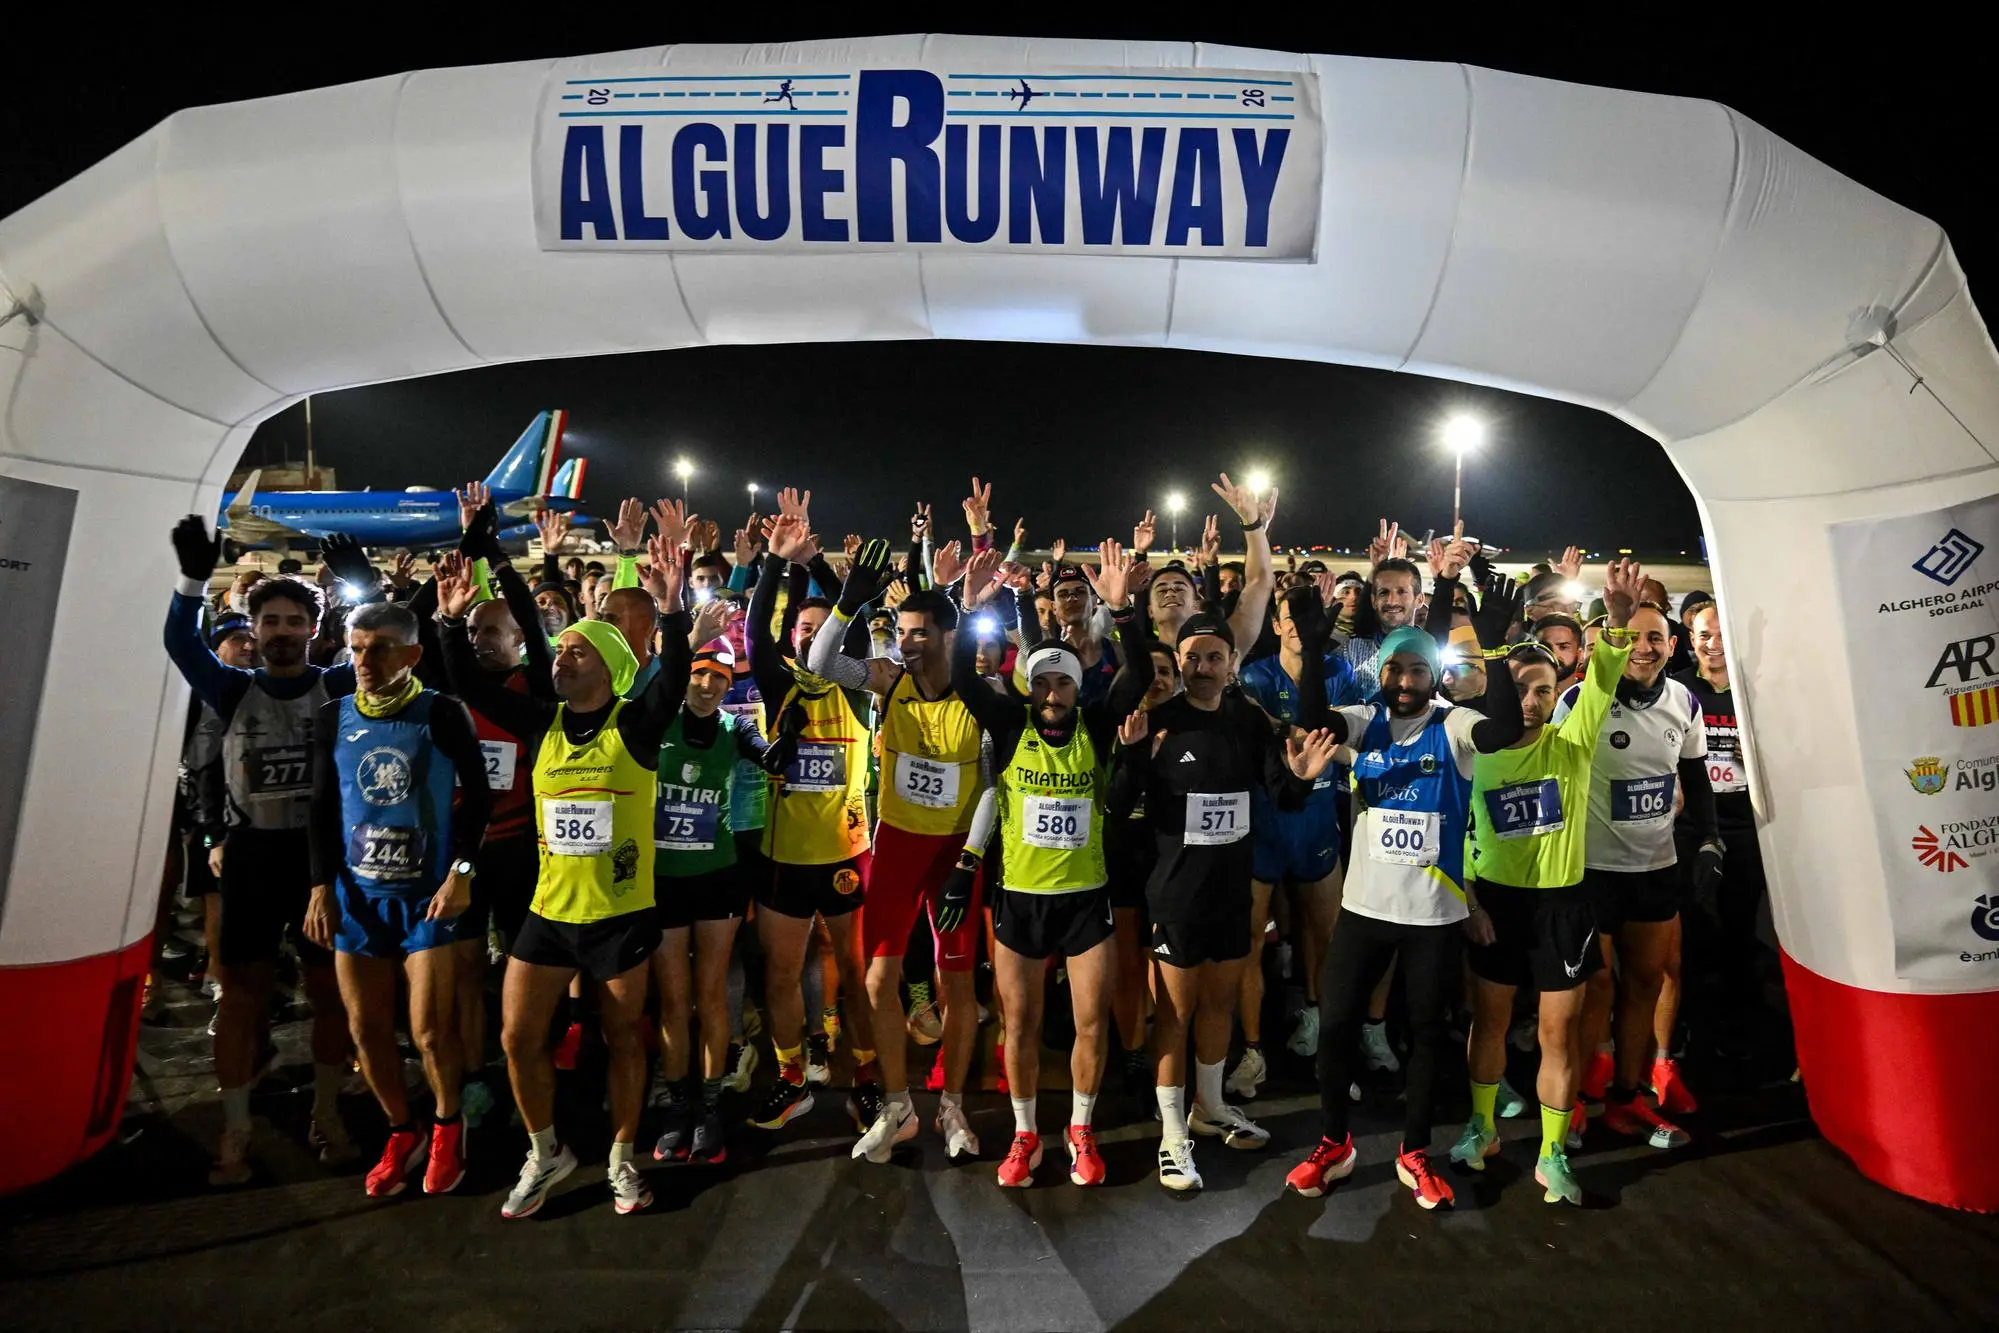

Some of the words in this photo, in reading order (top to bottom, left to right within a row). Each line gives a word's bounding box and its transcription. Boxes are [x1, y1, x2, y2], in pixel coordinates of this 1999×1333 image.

[588, 87, 610, 106] 20
[1242, 89, 1265, 108] 26
[560, 69, 1291, 248] ALGUERUNWAY
[1878, 592, 1956, 613] ALGHERO
[1929, 599, 1984, 617] SOGEAAL
[1924, 633, 1999, 688] AR
[262, 762, 306, 784] 277
[798, 759, 834, 778] 189
[1710, 766, 1733, 782] 06
[907, 771, 944, 796] 523
[1378, 781, 1420, 802] Vestis
[1503, 799, 1544, 822] 211
[1628, 792, 1664, 814] 106
[555, 819, 595, 840] 586
[669, 816, 695, 836] 75
[1036, 814, 1077, 836] 580
[1200, 810, 1235, 830] 571
[1381, 828, 1424, 851] 600
[362, 840, 408, 864] 244
